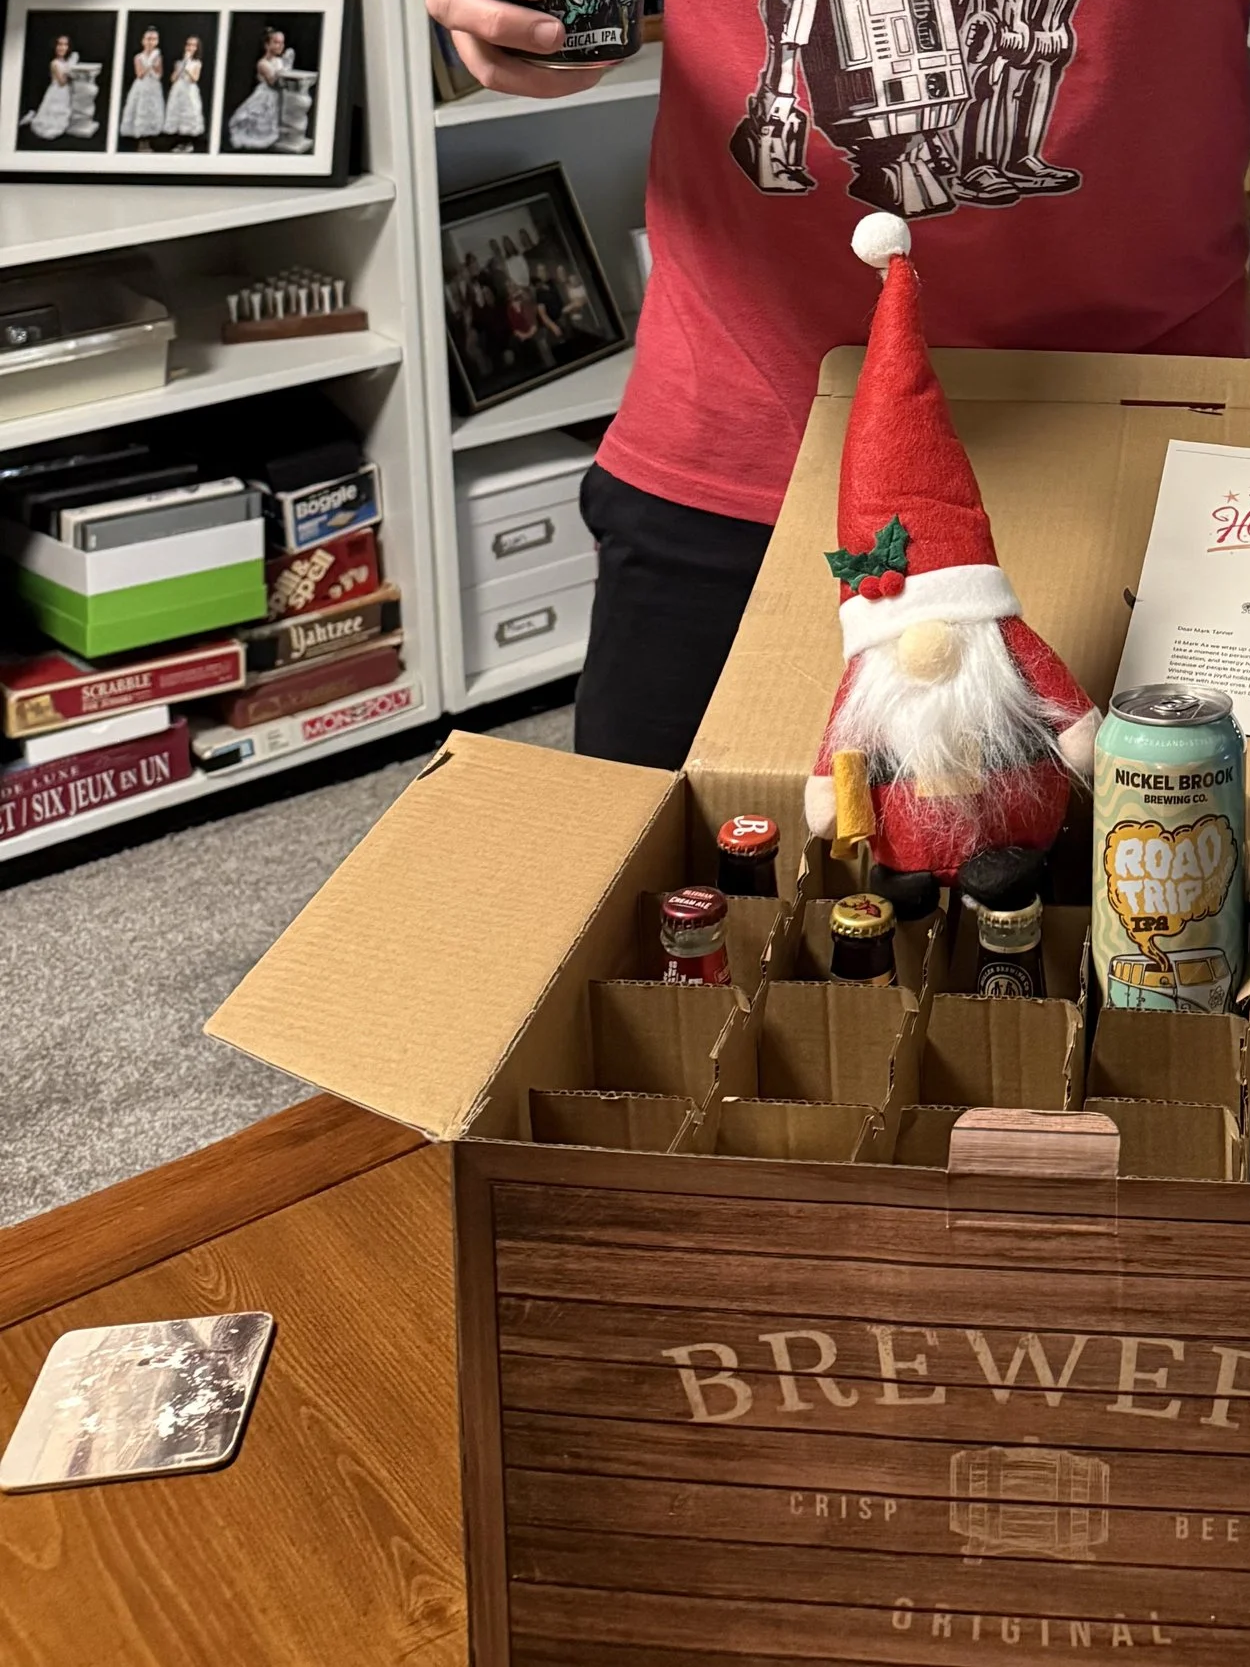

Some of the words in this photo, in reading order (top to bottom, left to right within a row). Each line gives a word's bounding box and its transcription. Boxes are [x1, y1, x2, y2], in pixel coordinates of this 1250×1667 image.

[564, 32, 598, 48] GICAL
[601, 30, 617, 42] IPA
[296, 485, 357, 518] Boggle
[290, 616, 363, 659] Yahtzee
[82, 673, 152, 698] SCRABBLE
[32, 786, 66, 822] SIX
[68, 768, 118, 816] JEUX
[119, 768, 139, 791] EN
[139, 752, 171, 785] UN
[1115, 768, 1175, 791] NICKEL
[1178, 766, 1234, 791] BROOK
[1144, 793, 1191, 805] BREWING
[1192, 793, 1208, 804] CO.
[1115, 825, 1222, 879] ROAD
[1117, 880, 1202, 914] TRIP
[1130, 916, 1170, 932] IPA
[789, 1493, 900, 1523] CRISP
[891, 1595, 1174, 1649] ORIGINAL
